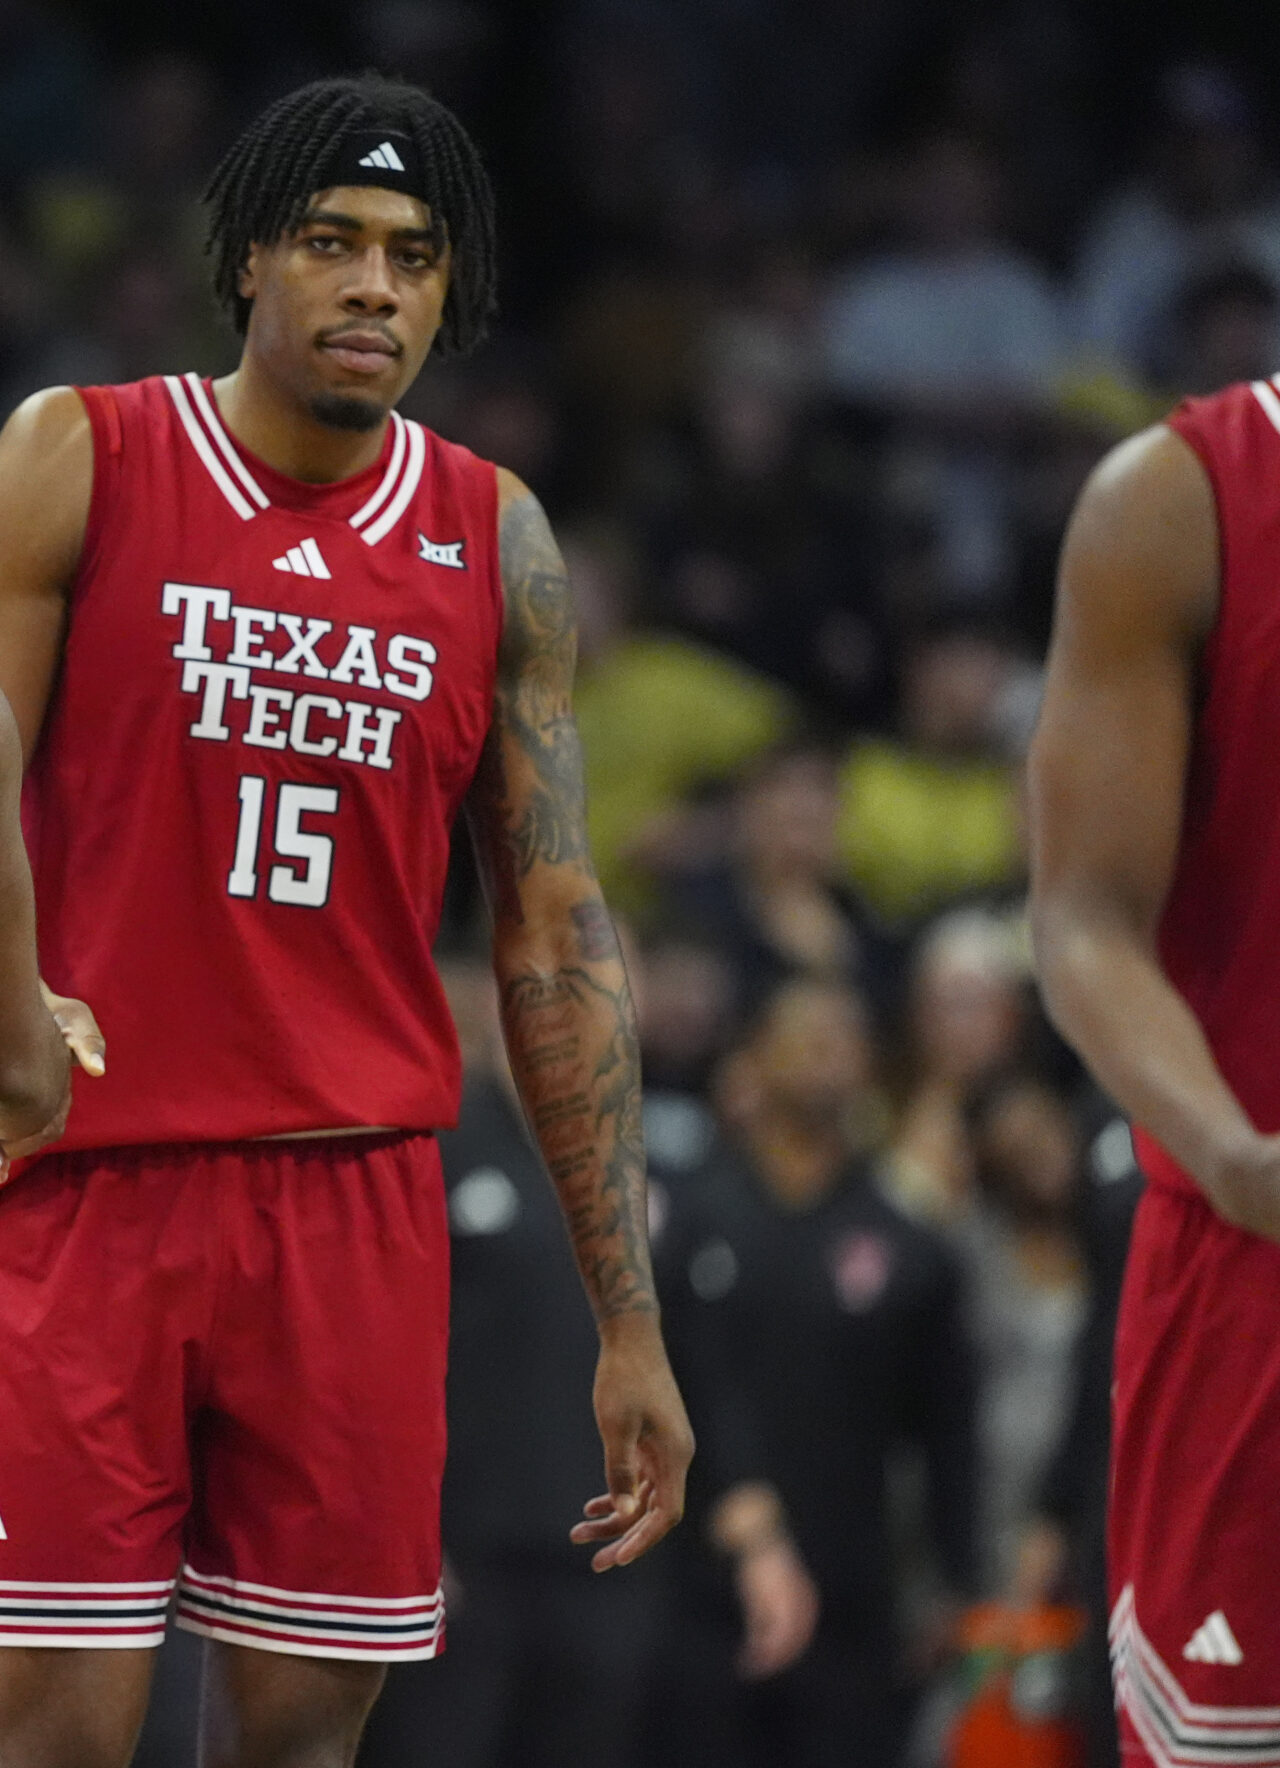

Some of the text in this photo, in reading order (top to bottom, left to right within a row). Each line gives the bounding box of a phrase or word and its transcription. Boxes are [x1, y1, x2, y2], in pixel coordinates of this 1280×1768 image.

[161, 582, 438, 702] TEXAS
[181, 660, 403, 770] TECH
[226, 775, 339, 908] 15
